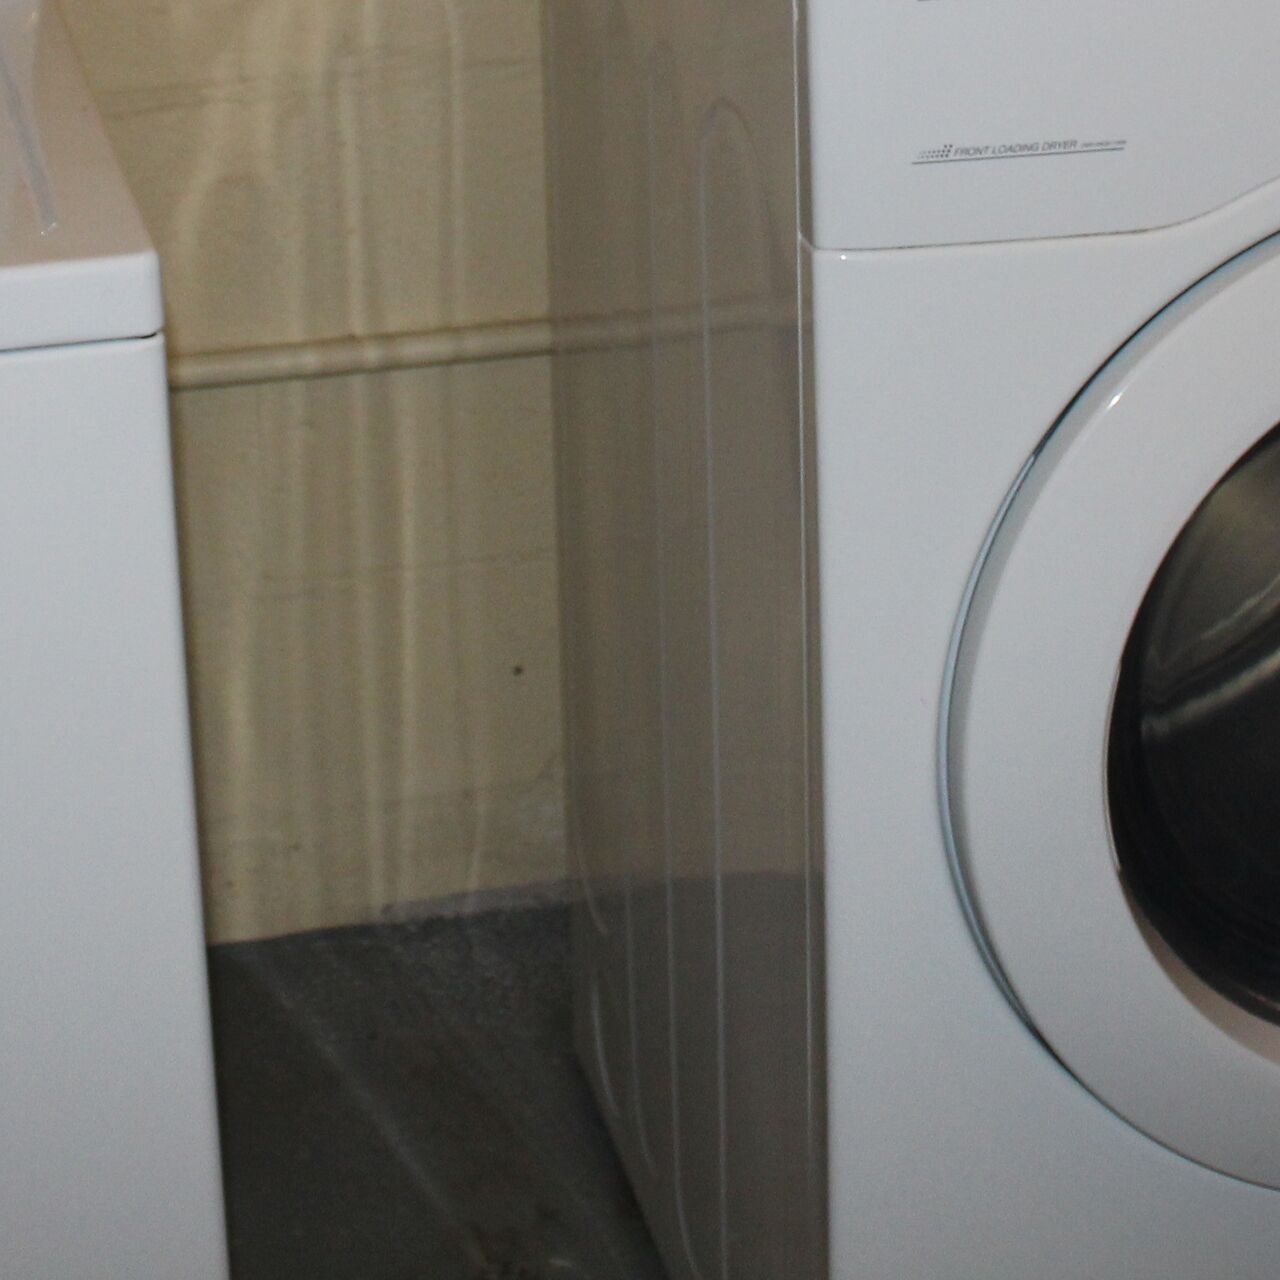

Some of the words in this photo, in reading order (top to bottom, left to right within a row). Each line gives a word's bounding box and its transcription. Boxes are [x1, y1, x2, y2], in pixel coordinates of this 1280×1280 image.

[953, 145, 991, 157] FRONT
[992, 142, 1040, 155] LOADING
[1041, 139, 1078, 151] DRYER
